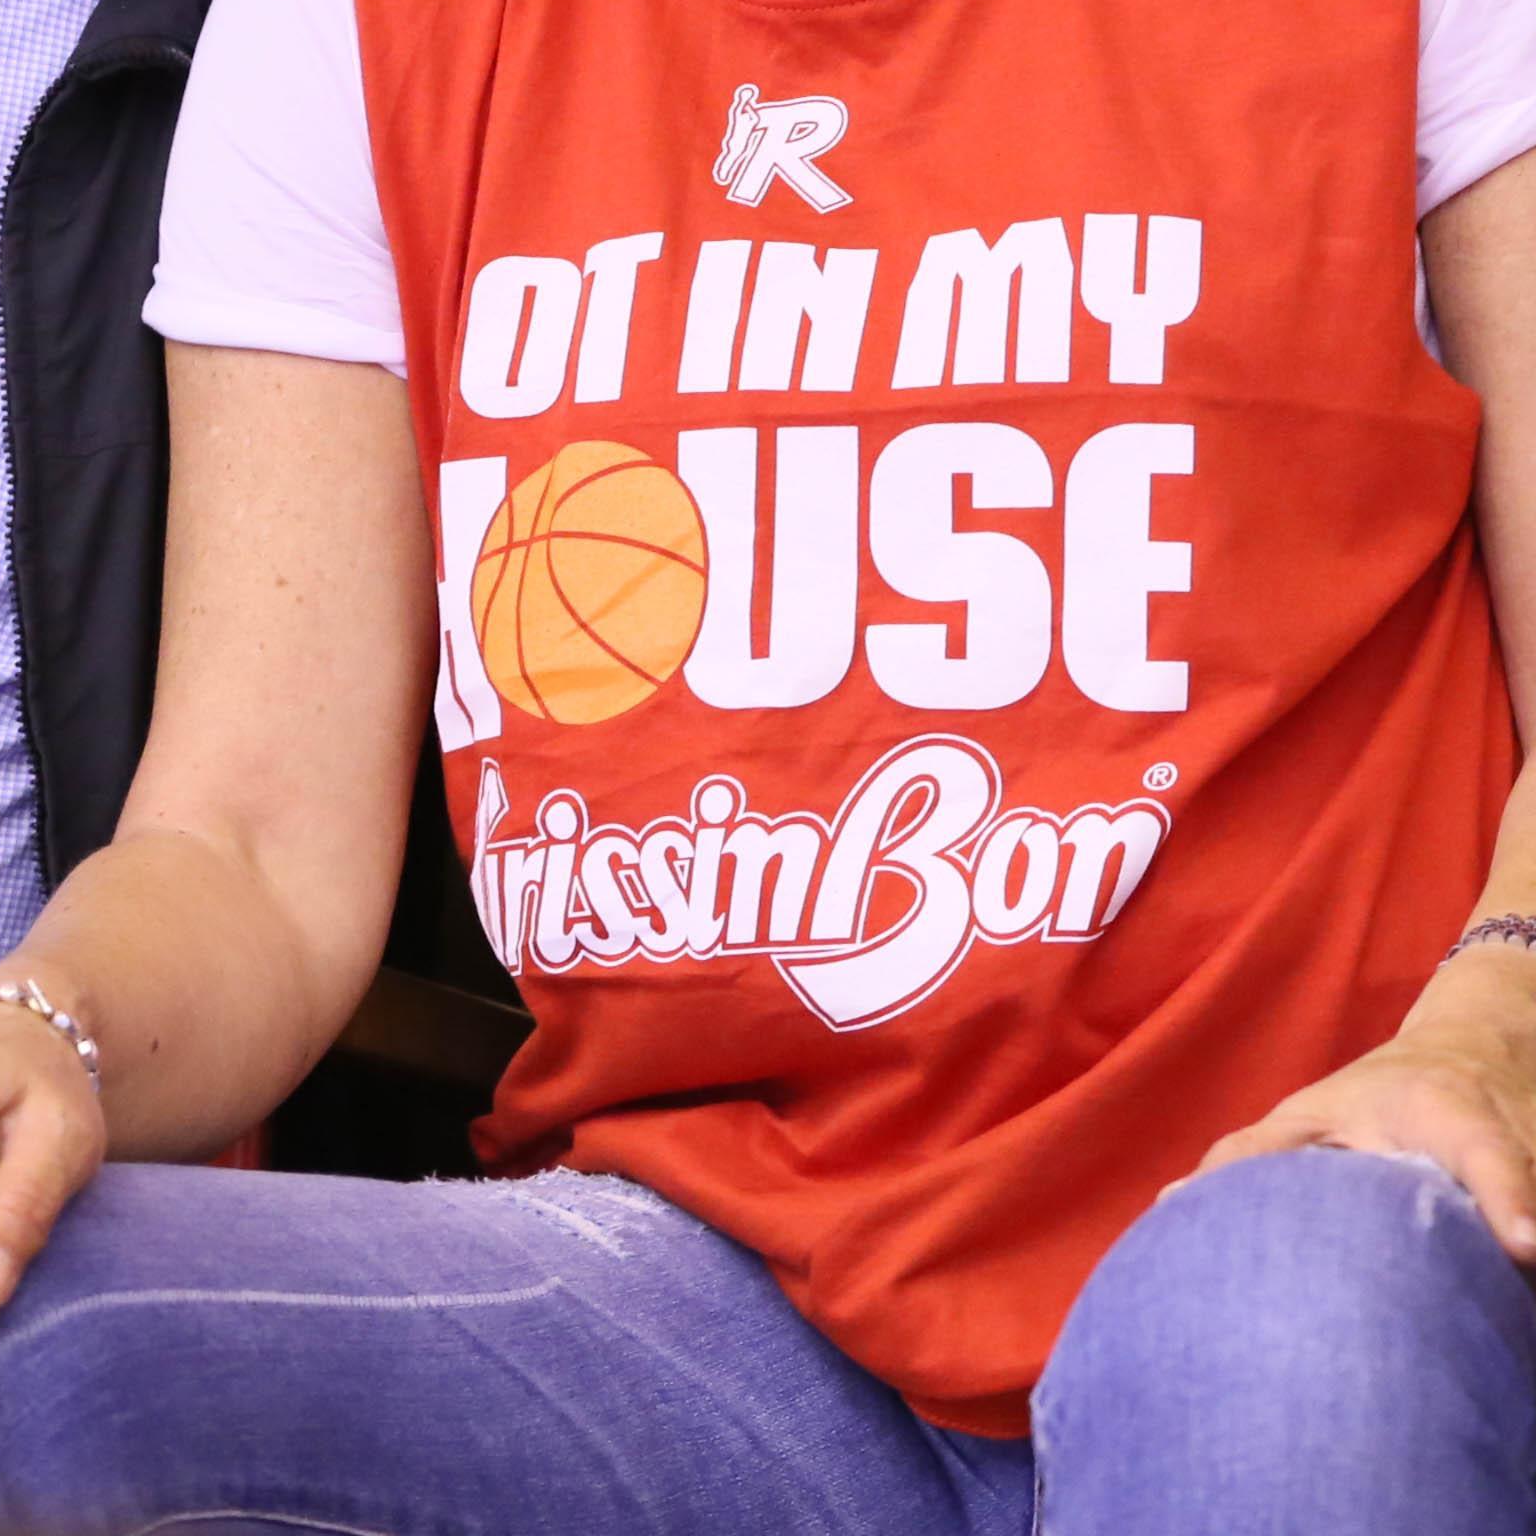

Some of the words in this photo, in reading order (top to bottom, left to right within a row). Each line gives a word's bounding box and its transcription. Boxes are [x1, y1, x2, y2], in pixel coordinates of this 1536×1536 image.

[459, 232, 665, 420] OT
[677, 240, 878, 394] IN
[891, 214, 1202, 393] MY
